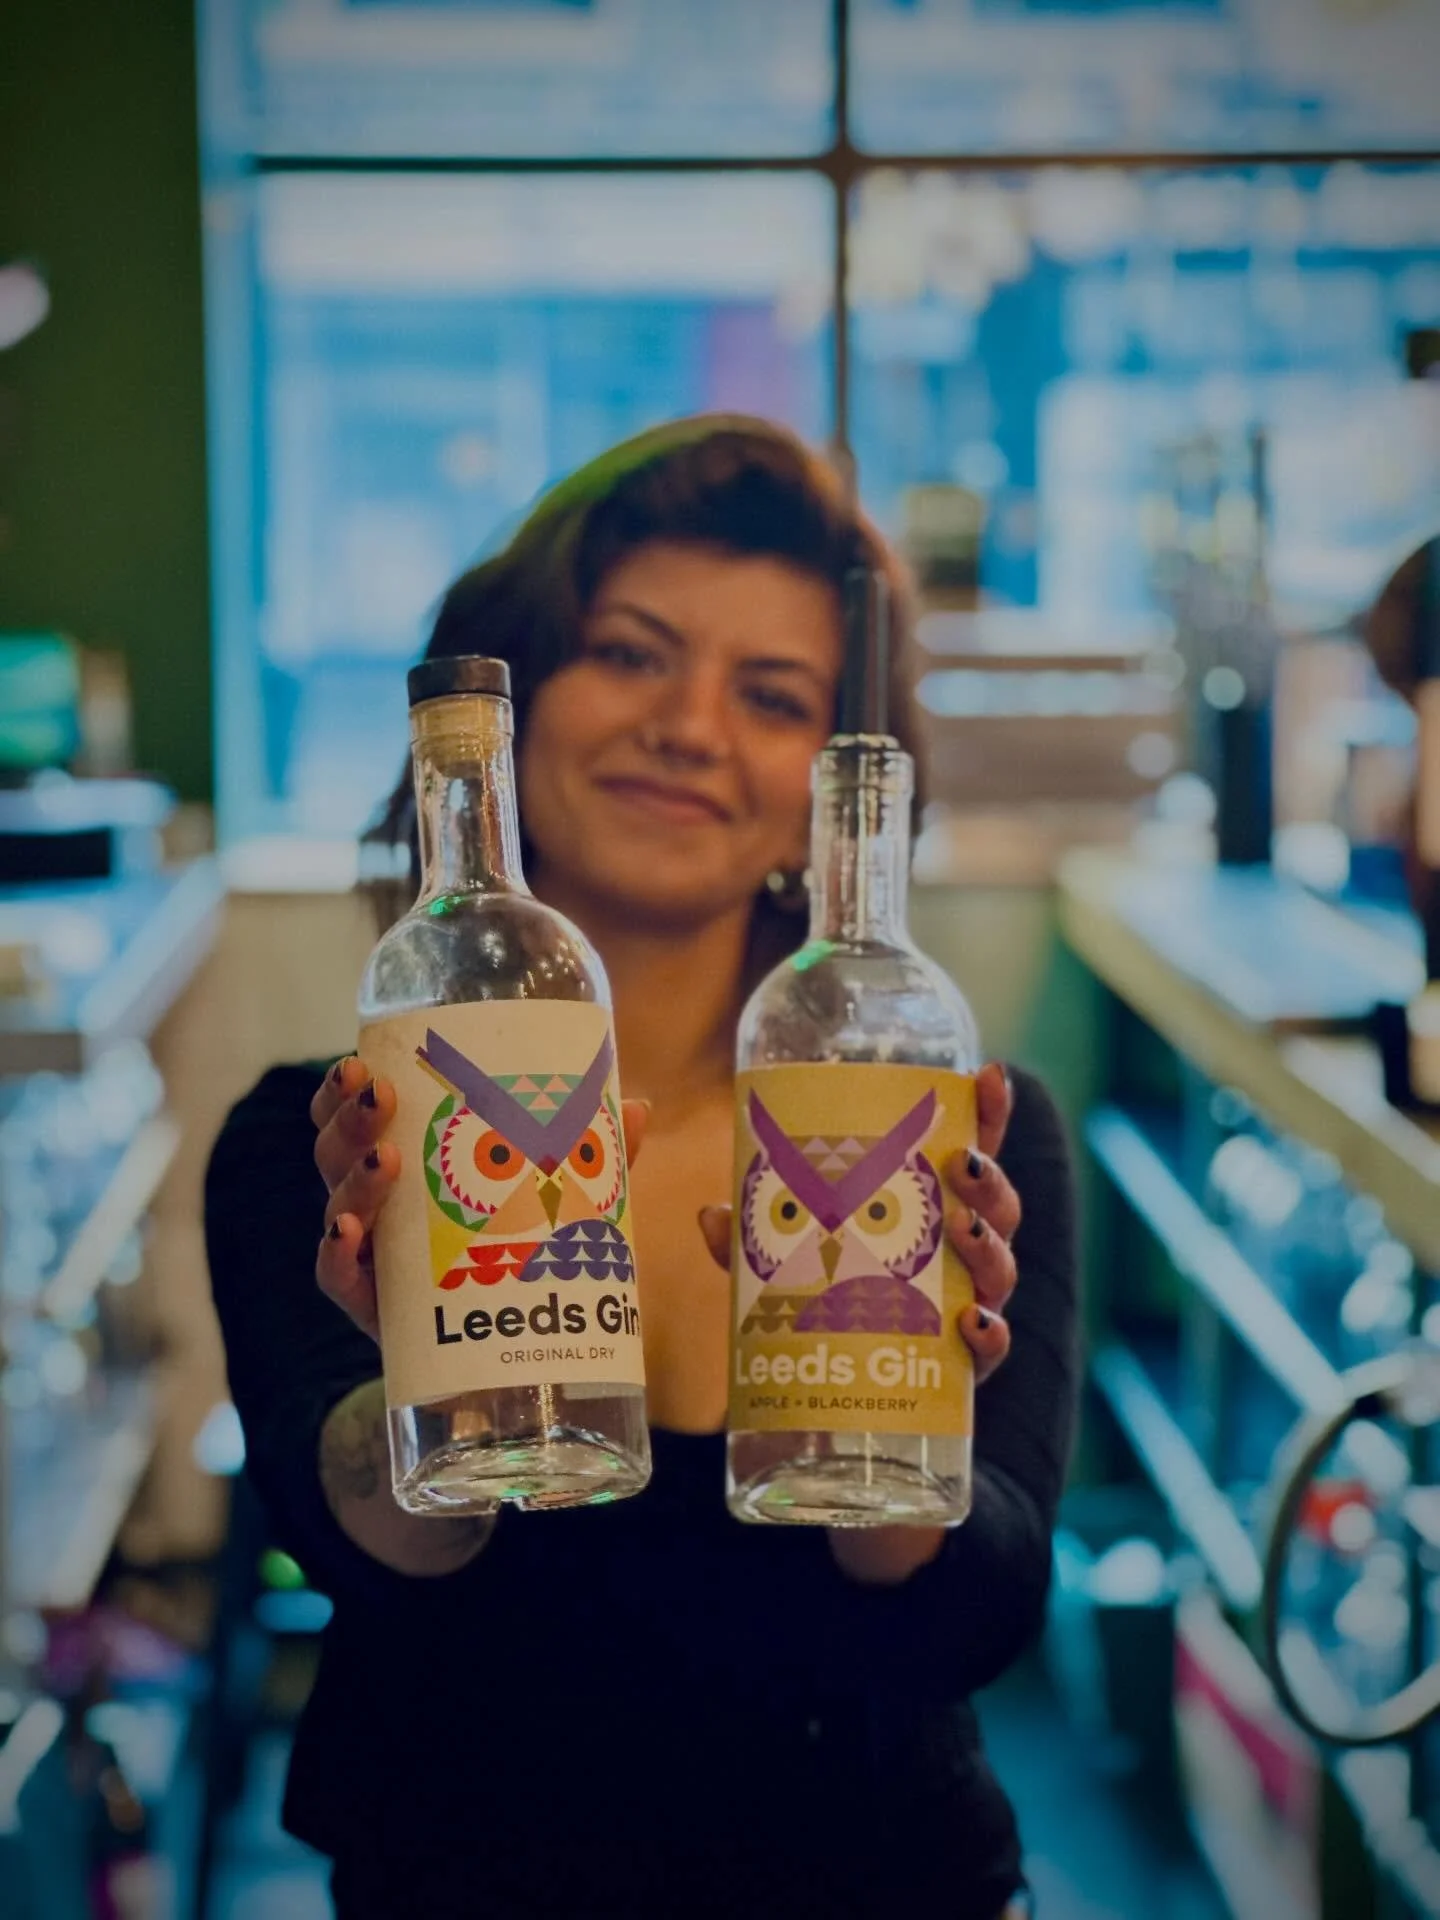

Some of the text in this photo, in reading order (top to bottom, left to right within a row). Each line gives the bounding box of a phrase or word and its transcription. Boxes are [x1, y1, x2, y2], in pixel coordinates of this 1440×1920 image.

[434, 1292, 640, 1345] Leeds Gin
[500, 1347, 615, 1364] ORIGINAL DRY
[735, 1343, 942, 1389] Leeds Gin
[807, 1396, 918, 1412] BLACKBERRY
